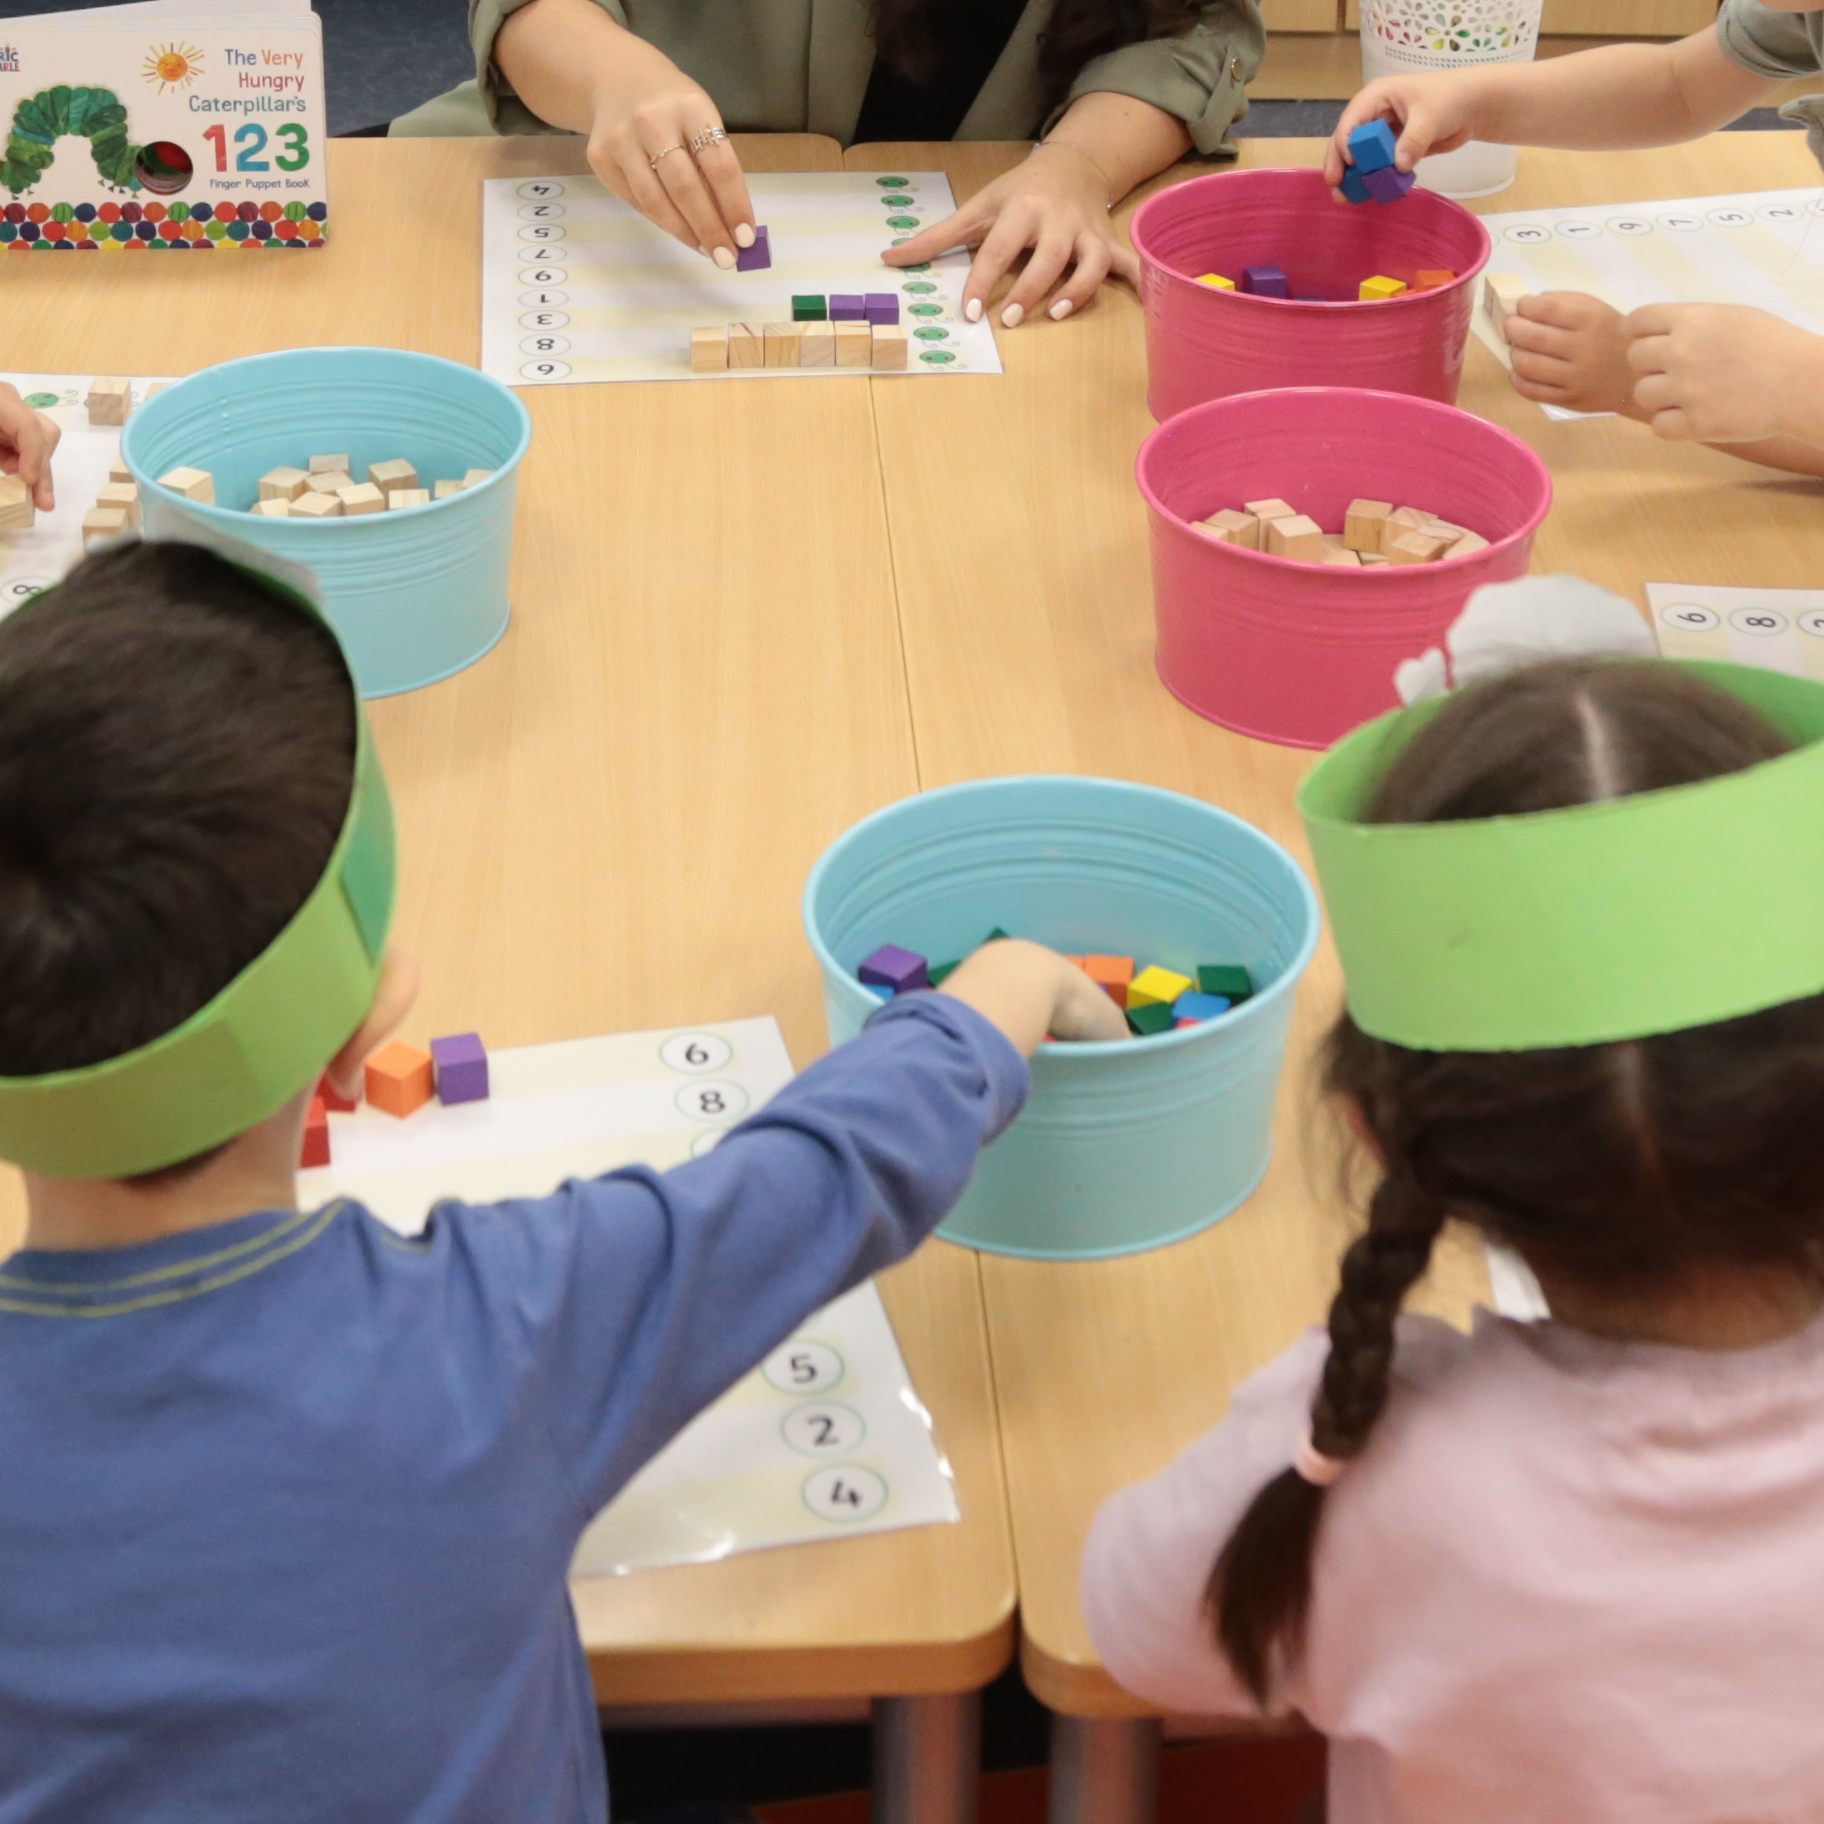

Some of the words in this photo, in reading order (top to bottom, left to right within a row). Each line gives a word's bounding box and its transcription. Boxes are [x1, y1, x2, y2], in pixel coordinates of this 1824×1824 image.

[225, 49, 257, 66] The
[262, 49, 304, 69] Very
[238, 72, 305, 92] Hungry
[189, 95, 307, 116] Caterpillar's
[210, 179, 241, 190] Finger
[246, 179, 281, 190] Puppet
[532, 185, 550, 196] 4
[534, 205, 549, 217] 2
[1770, 209, 1792, 217] 2
[534, 227, 550, 238] 5
[1517, 230, 1541, 239] 3
[534, 248, 551, 259] 7
[540, 294, 549, 304] 1
[536, 314, 552, 325] 3
[536, 338, 555, 351] 8
[1748, 617, 1776, 629] 8
[685, 1044, 709, 1064] 6
[699, 1091, 726, 1113] 8
[790, 1357, 818, 1382] 5
[806, 1416, 842, 1446] 2
[831, 1481, 860, 1506] 4
